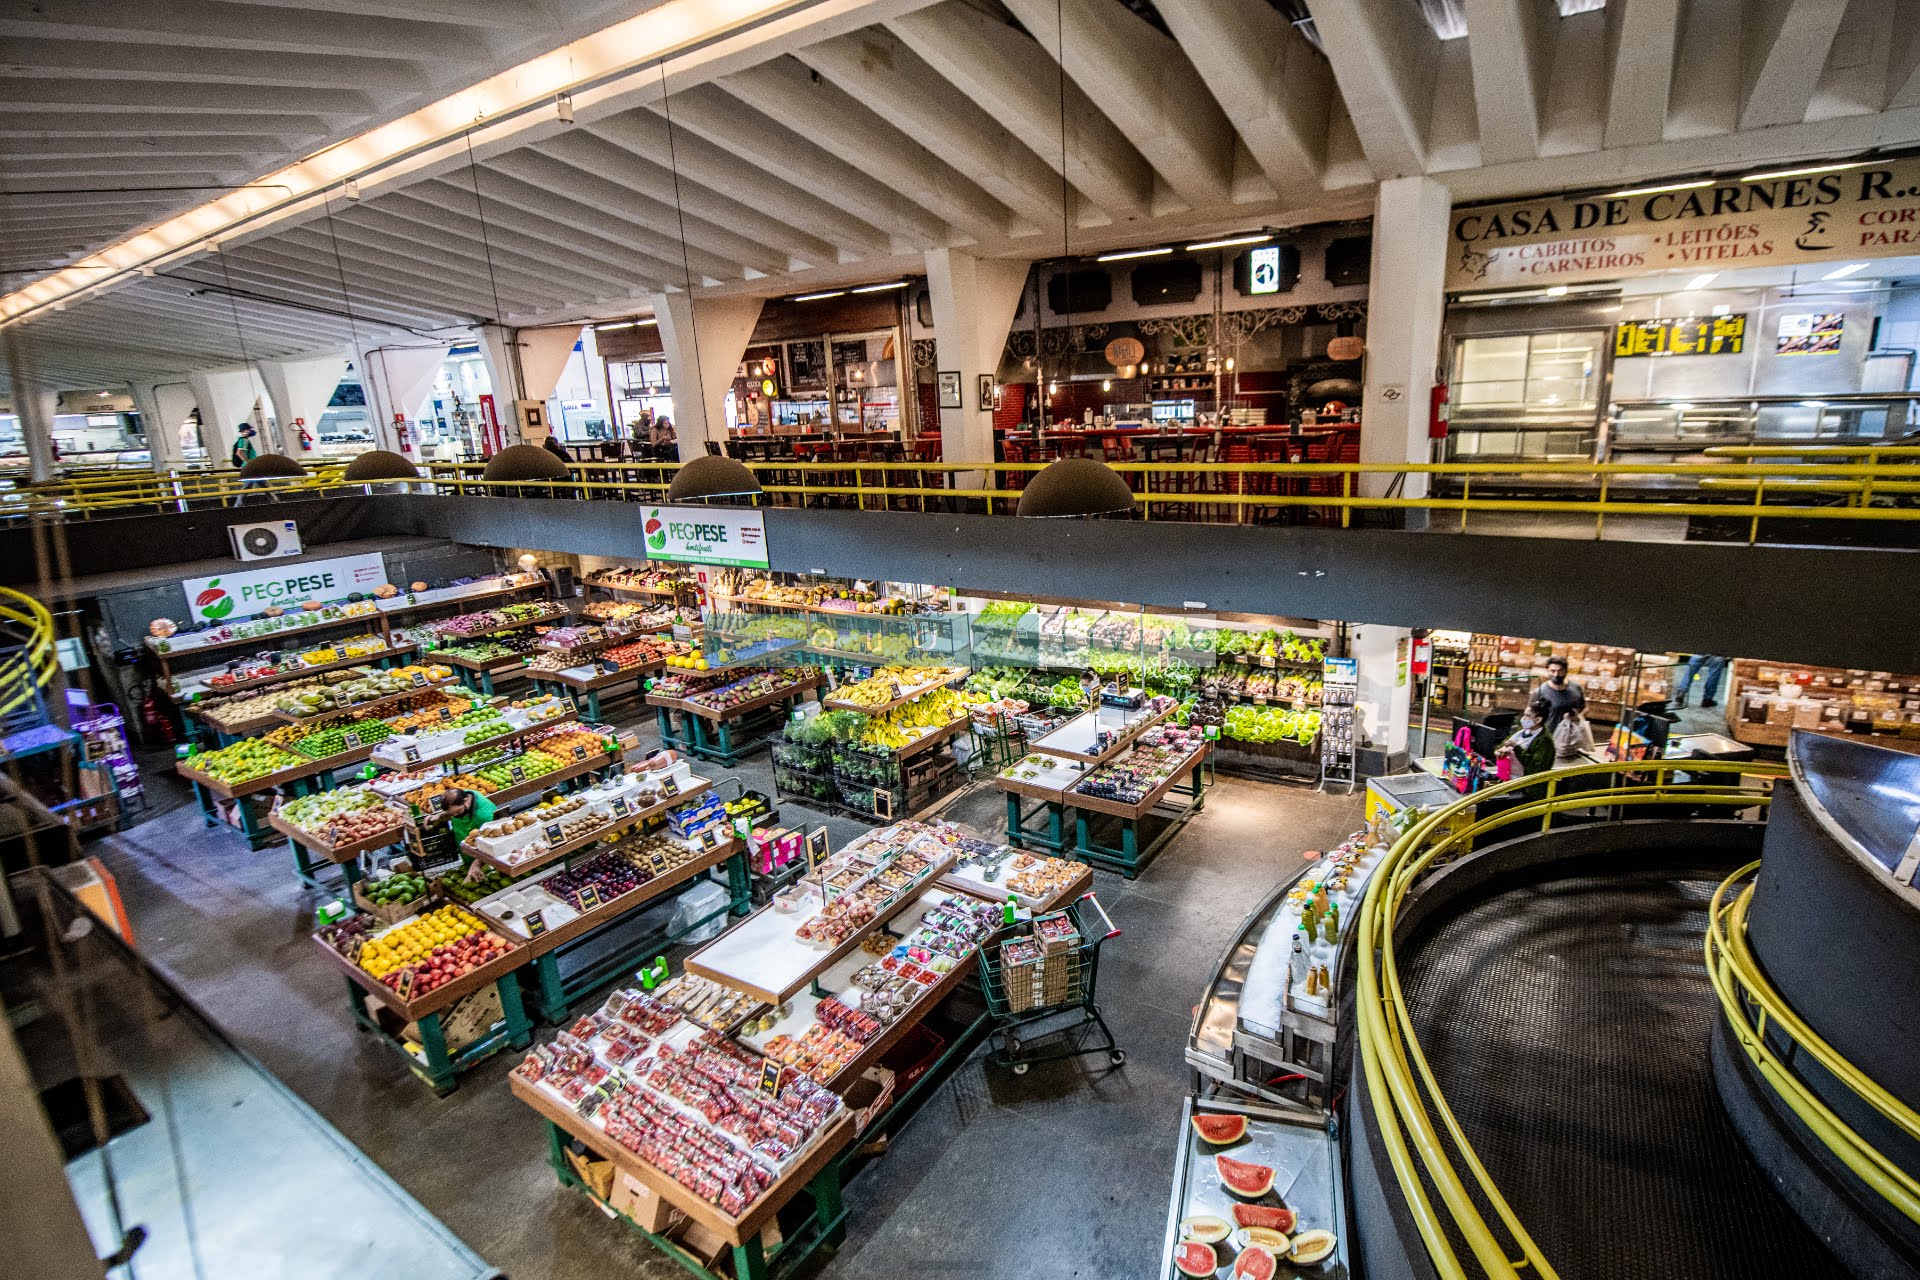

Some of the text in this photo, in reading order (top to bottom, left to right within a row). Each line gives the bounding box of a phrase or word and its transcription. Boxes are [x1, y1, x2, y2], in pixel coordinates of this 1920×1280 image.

[1455, 207, 1560, 242] CASA
[1573, 198, 1629, 230] DE
[1644, 174, 1842, 222] CARNES
[1859, 207, 1920, 226] COR
[1666, 222, 1760, 247] LEITÕES
[1519, 237, 1617, 260] CABRITOS
[1680, 239, 1774, 262] VITELAS
[1531, 251, 1645, 274] CARNEIROS
[668, 522, 727, 543] PEGPESE
[241, 572, 335, 602] PEGPESE
